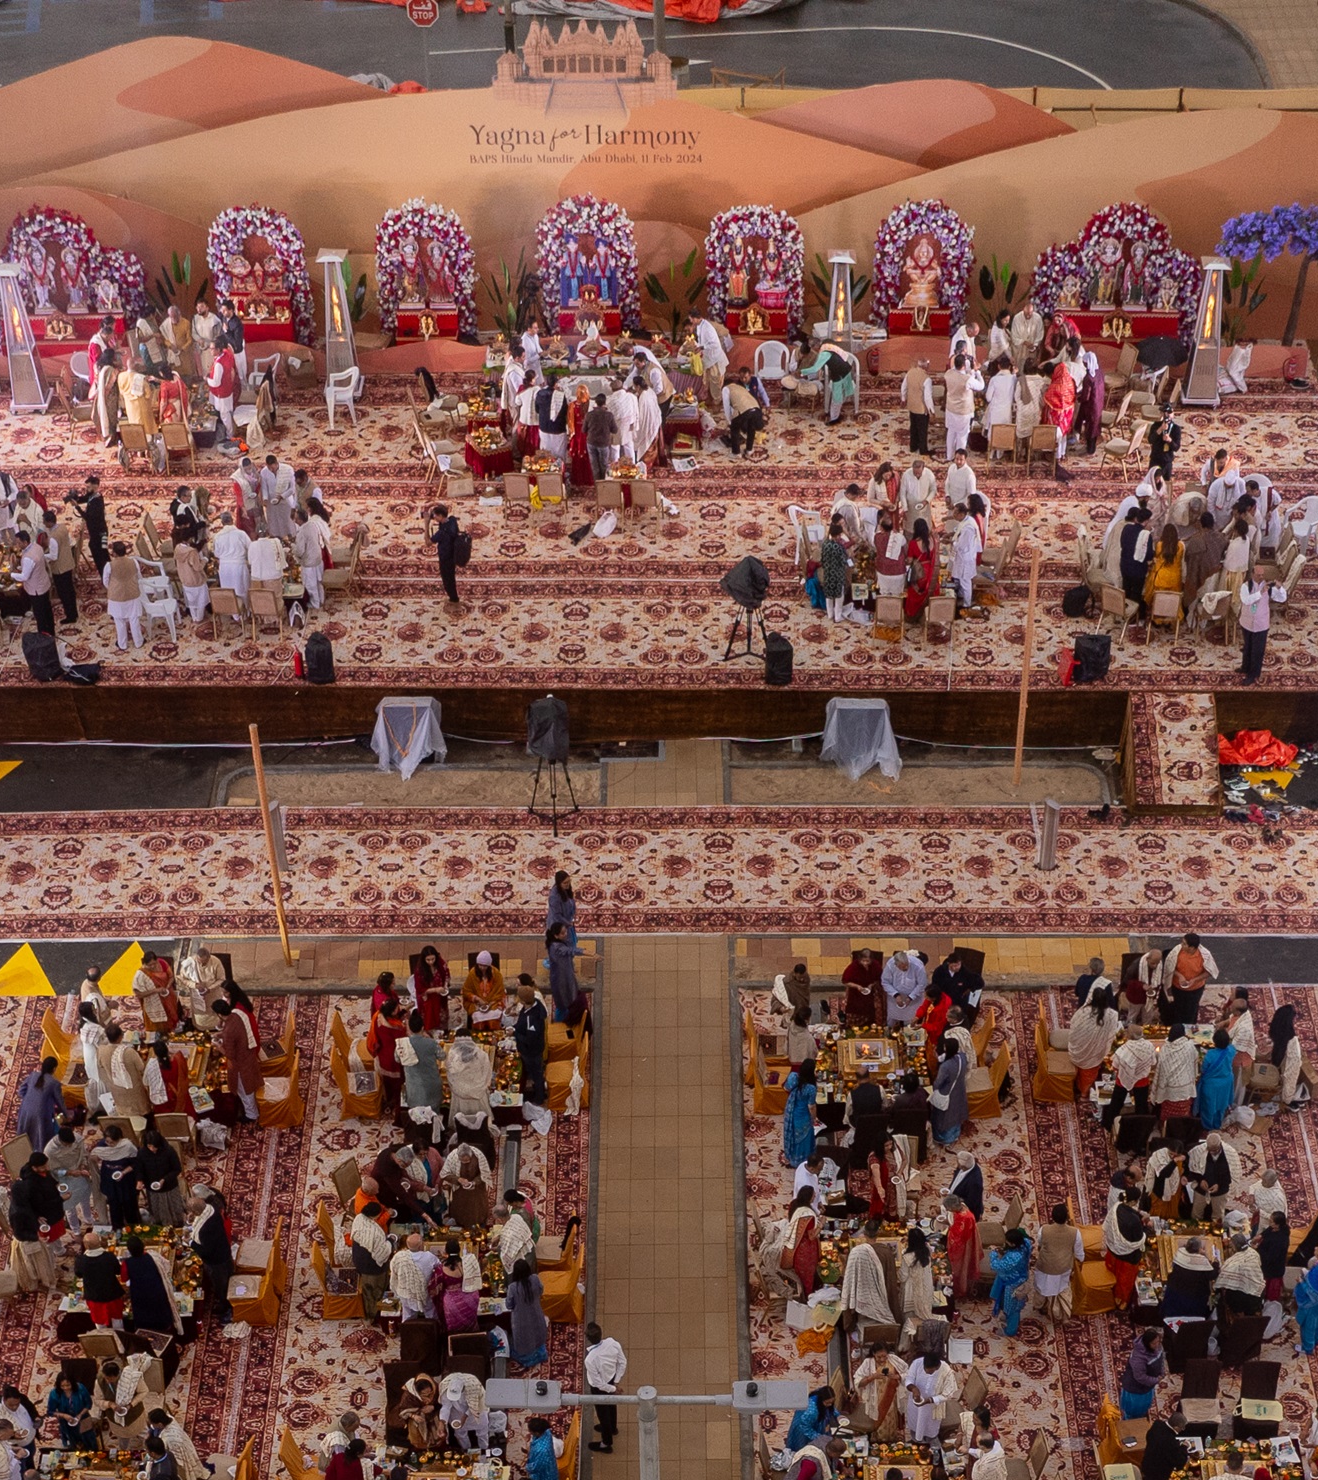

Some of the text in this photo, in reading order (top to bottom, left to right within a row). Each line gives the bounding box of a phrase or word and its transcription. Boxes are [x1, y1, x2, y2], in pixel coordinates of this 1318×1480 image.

[412, 11, 434, 20] STOP
[469, 124, 701, 153] Yagna for Harmony
[469, 154, 498, 164] BAPS
[501, 154, 533, 164] Hindu
[537, 154, 577, 165] Mandir,
[580, 154, 601, 164] Abu
[605, 154, 638, 165] Dhabi,
[653, 154, 672, 164] Feb
[676, 154, 703, 164] 2024
